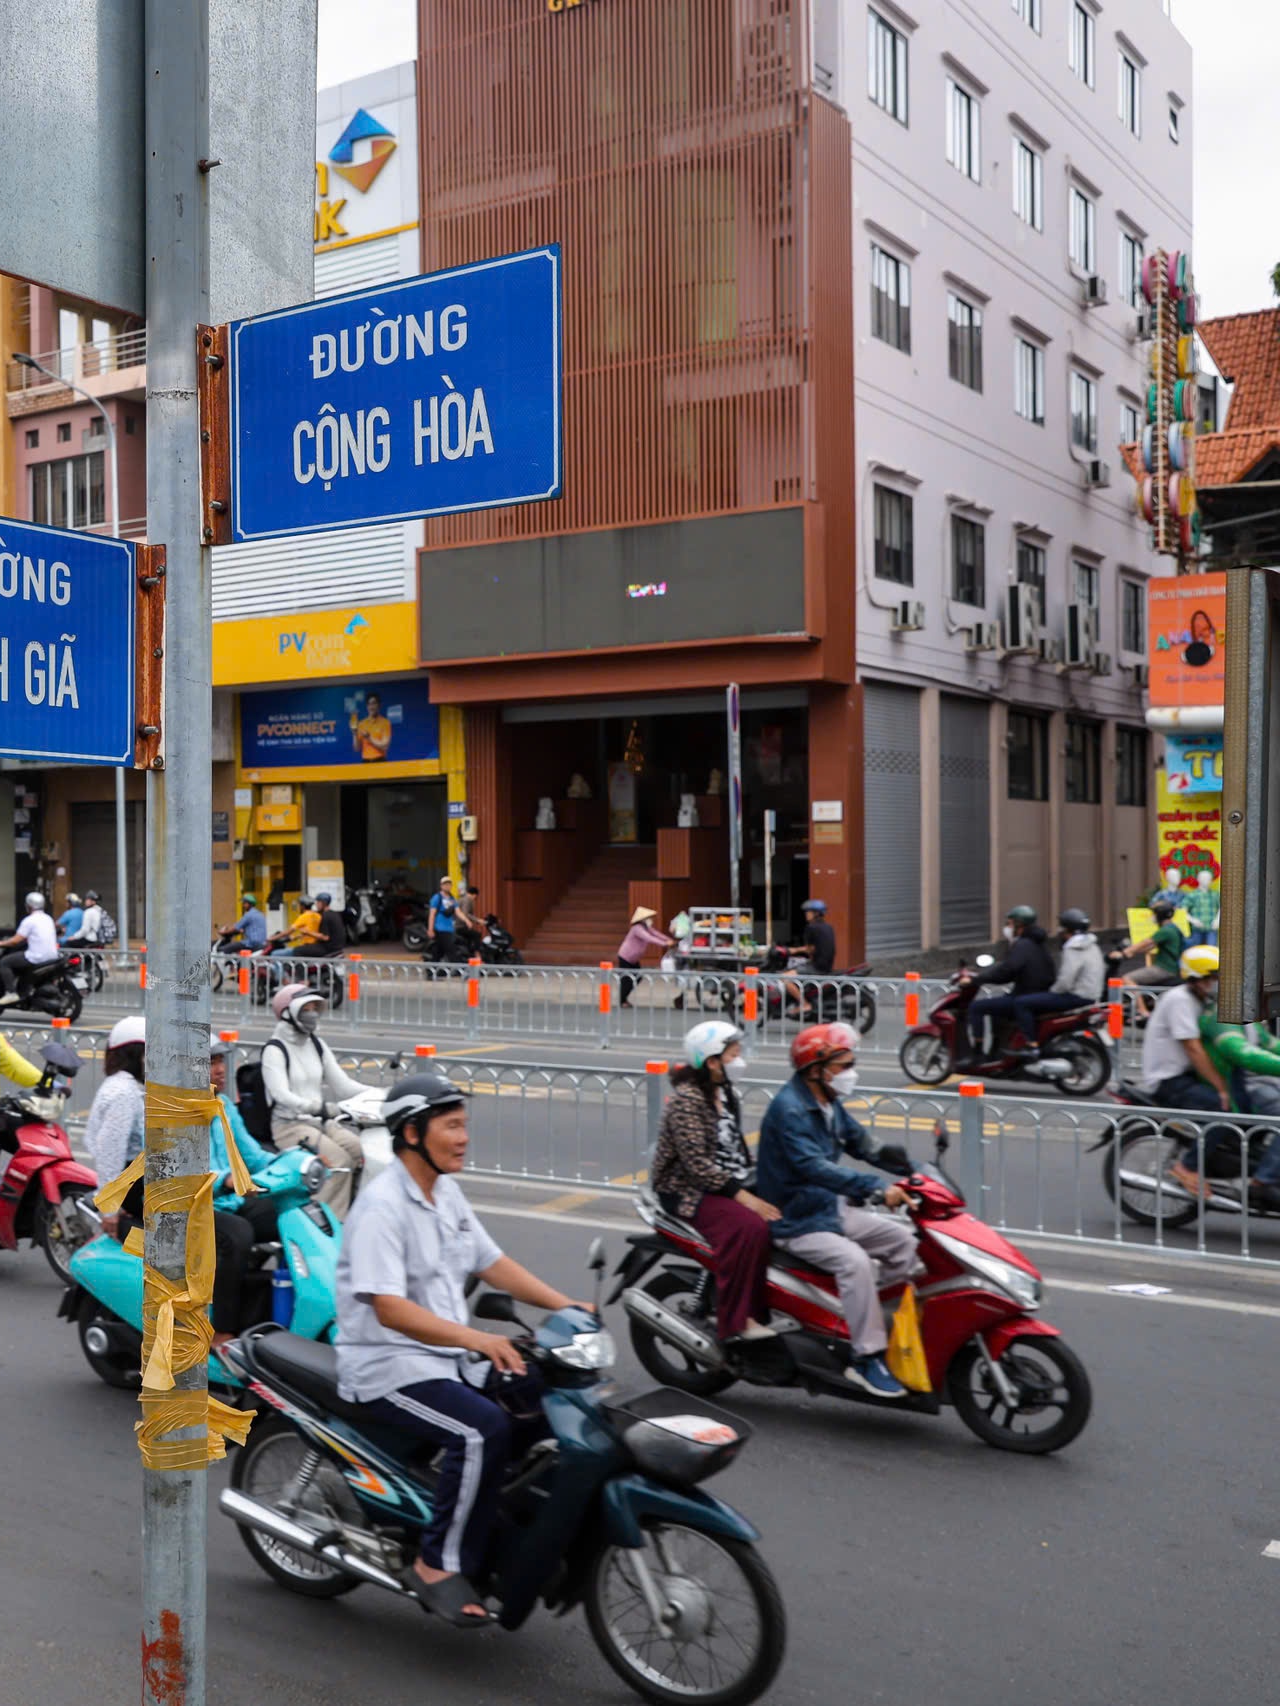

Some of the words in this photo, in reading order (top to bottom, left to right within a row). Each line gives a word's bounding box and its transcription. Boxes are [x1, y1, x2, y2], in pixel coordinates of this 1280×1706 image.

[309, 304, 468, 379] ĐƯỜNG
[293, 403, 391, 491] CỘNG
[413, 375, 495, 466] HÒA
[24, 633, 80, 709] GIÃ
